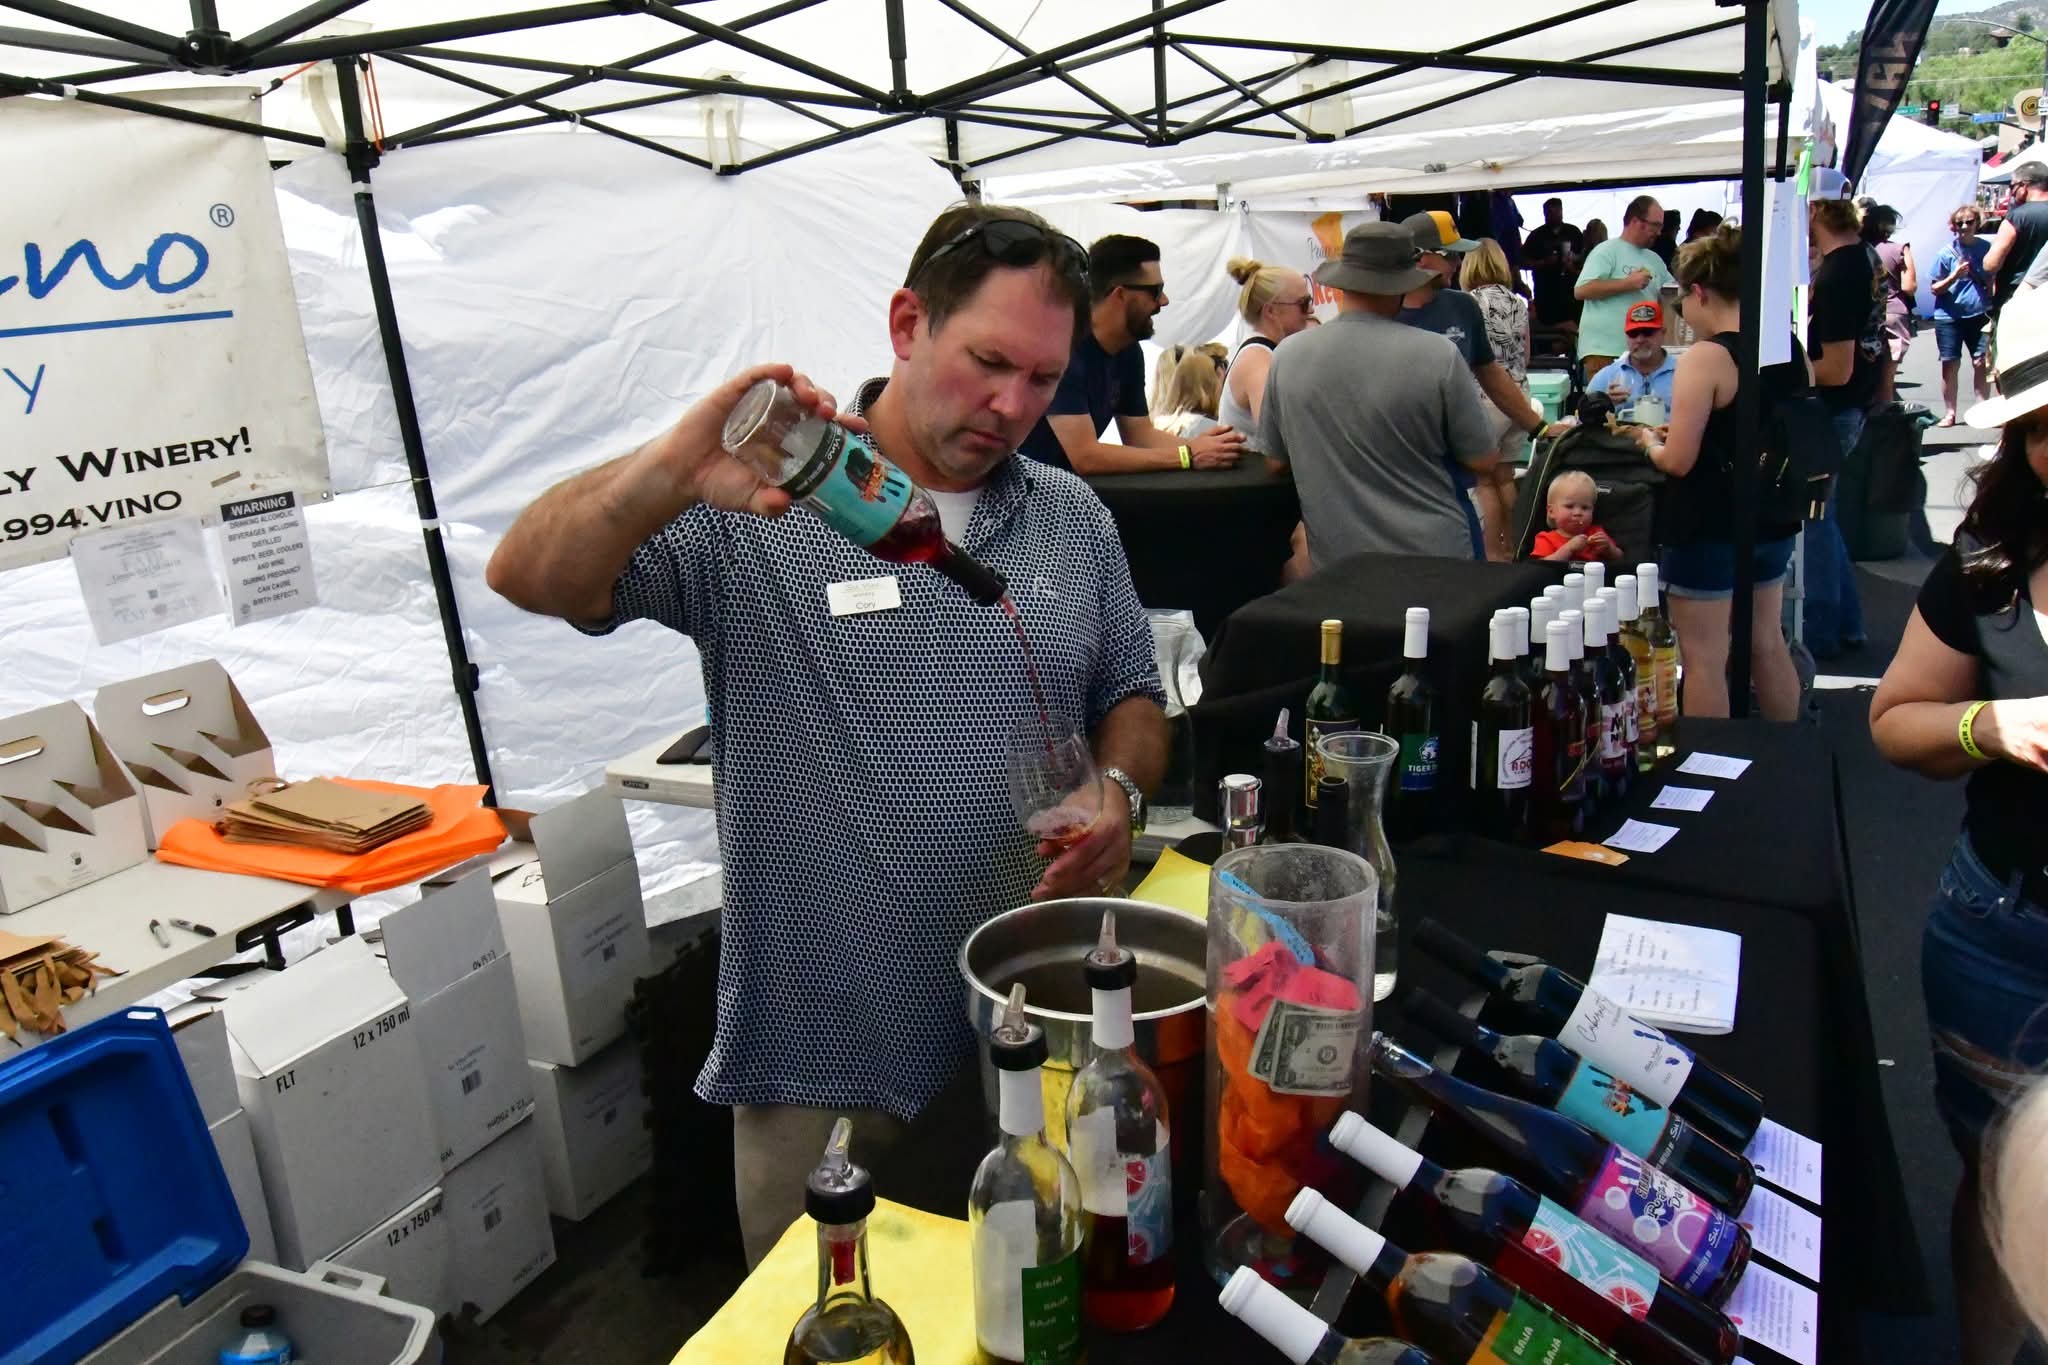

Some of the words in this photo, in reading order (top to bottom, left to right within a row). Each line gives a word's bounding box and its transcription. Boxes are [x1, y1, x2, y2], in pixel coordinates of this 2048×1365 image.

[231, 496, 287, 516] WARNING
[352, 1031, 366, 1050] 12
[368, 1029, 375, 1042] x
[376, 1013, 396, 1038] 750
[275, 1070, 297, 1094] FLT
[387, 1229, 401, 1248] 12
[402, 1224, 410, 1238] x
[410, 1209, 431, 1232] 750
[1513, 1325, 1534, 1357] BAJA
[1541, 1337, 1562, 1365] BAJA
